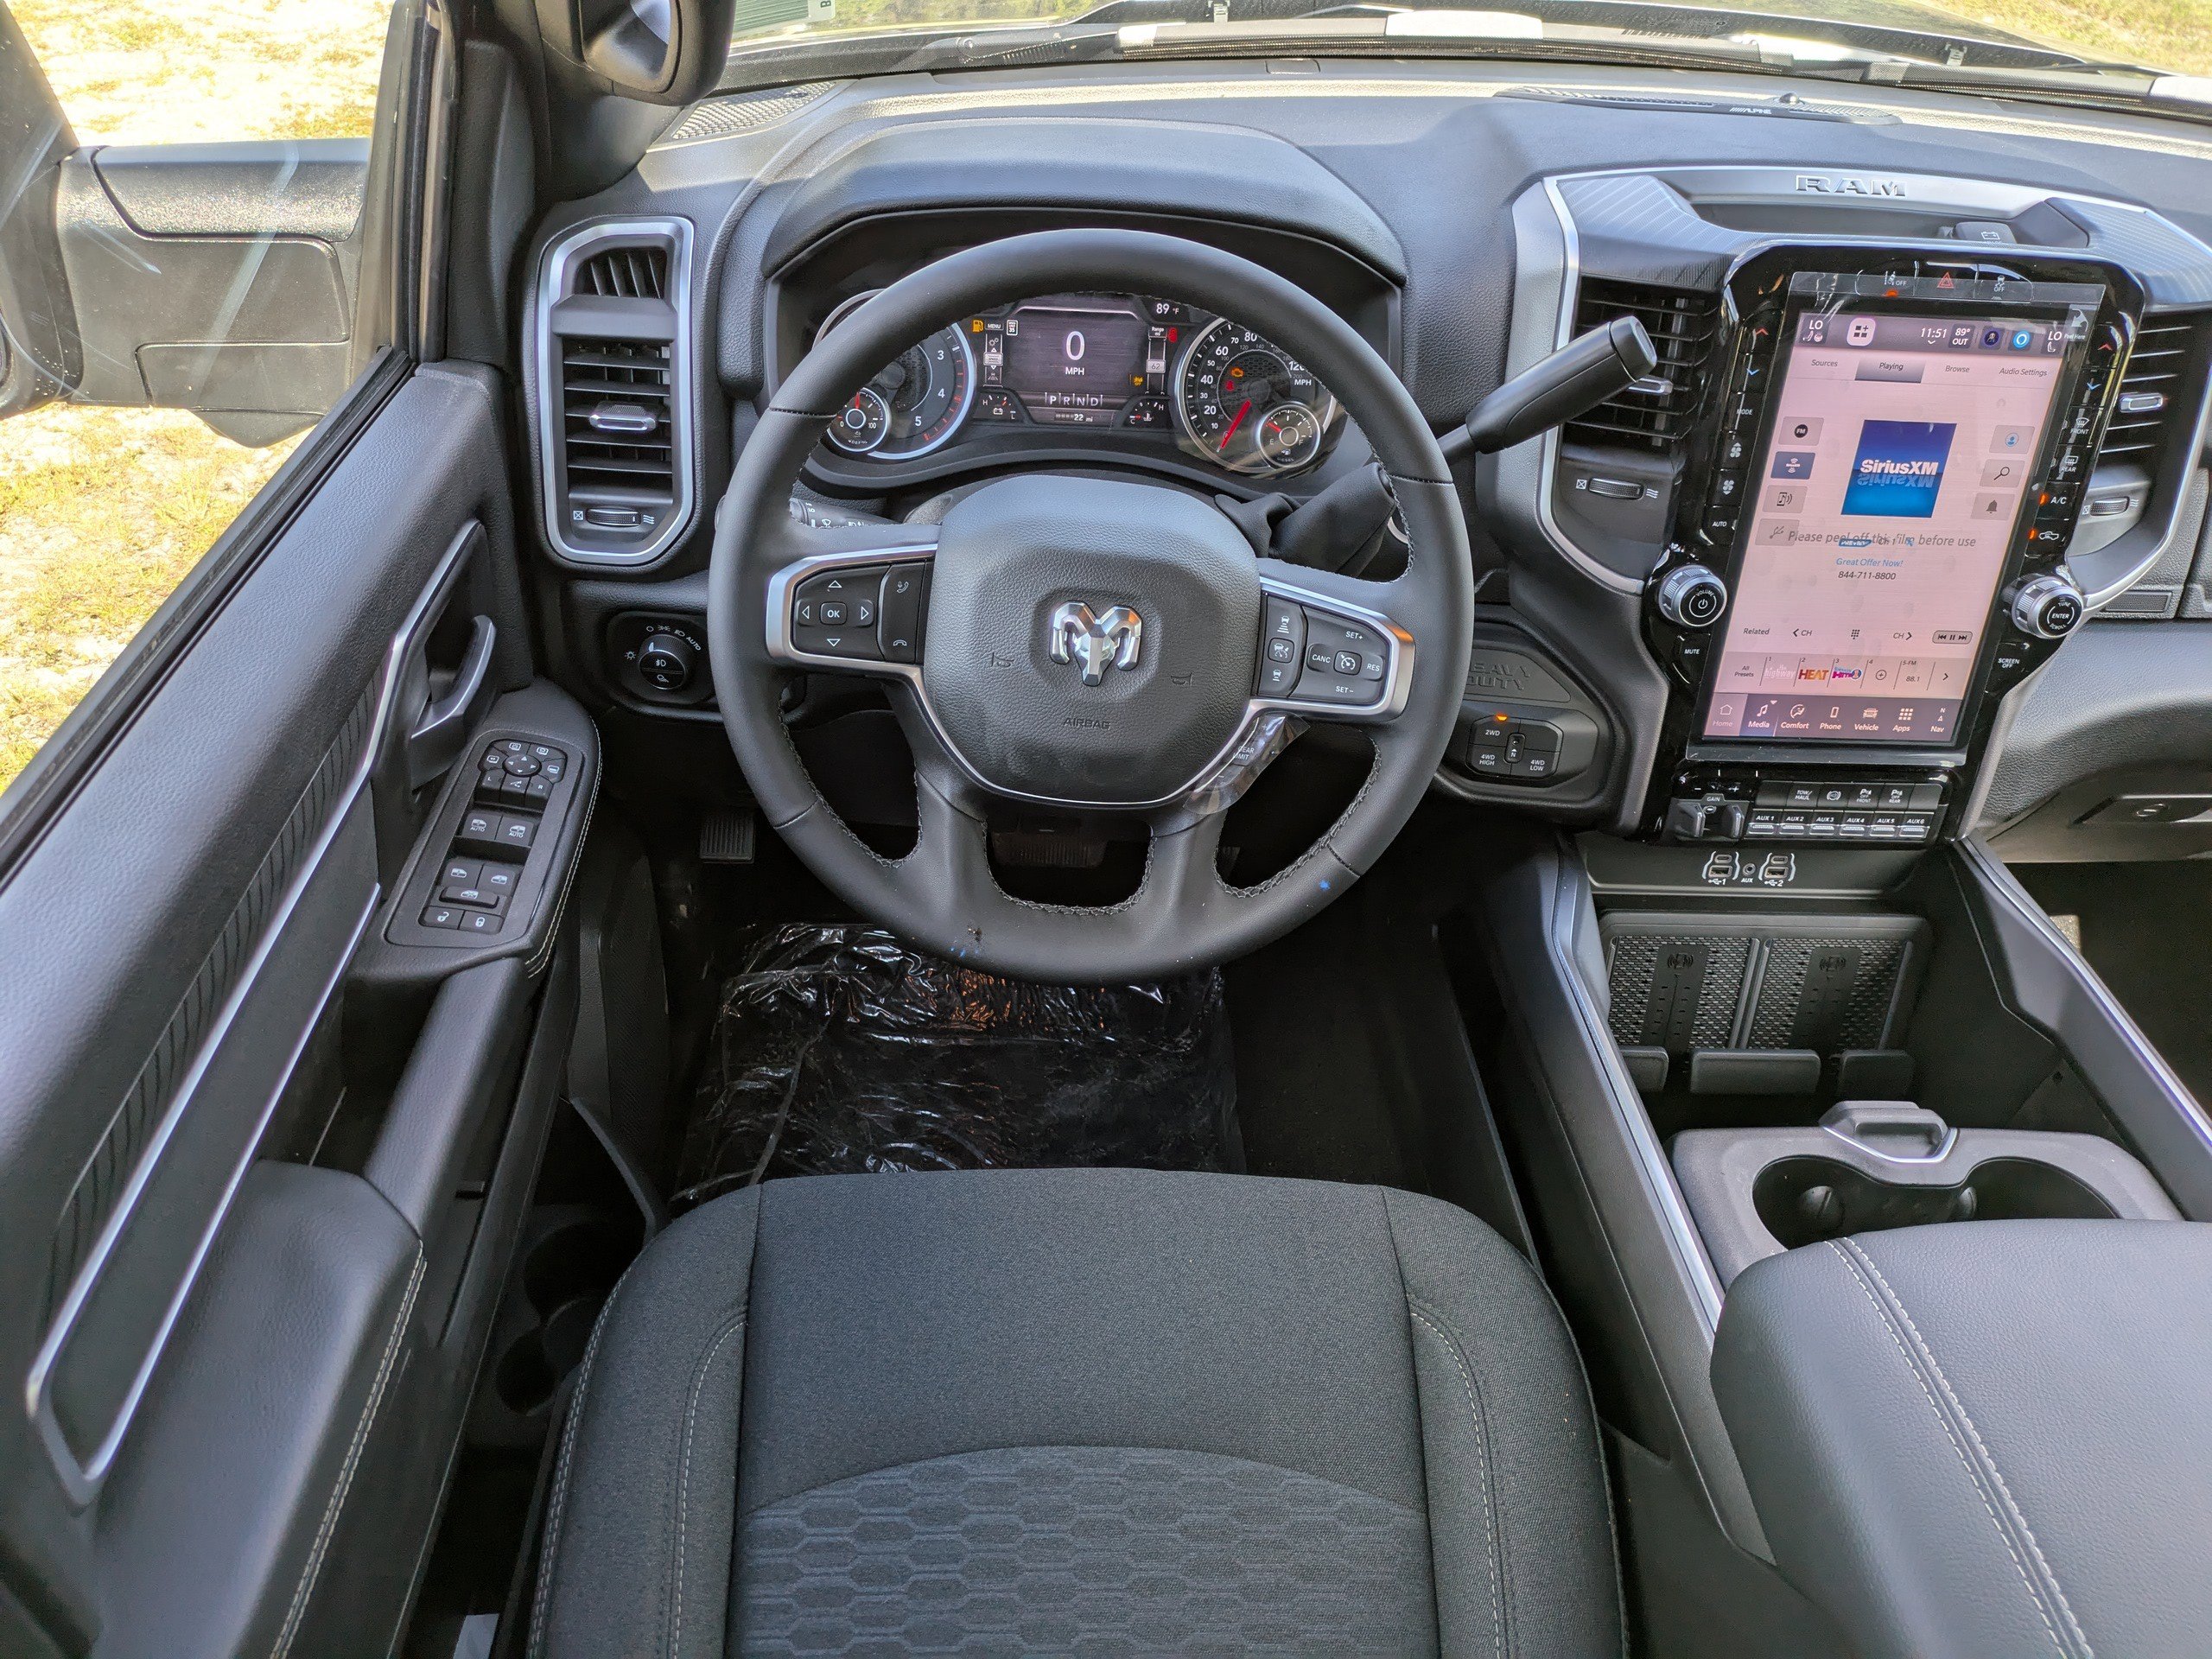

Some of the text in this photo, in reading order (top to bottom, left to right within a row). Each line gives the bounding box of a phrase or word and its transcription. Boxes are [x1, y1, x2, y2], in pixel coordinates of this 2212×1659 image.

[1795, 175, 1907, 197] RAM
[1156, 303, 1169, 315] 89
[1808, 320, 1823, 330] LO
[1244, 332, 1257, 342] 80
[1921, 327, 1948, 339] 11:51
[2048, 331, 2063, 341] LO
[1065, 330, 1085, 361] 0
[937, 350, 944, 360] 3
[1215, 346, 1229, 356] 60
[1065, 367, 1084, 376] MPH
[1878, 362, 1904, 371] Playing
[1945, 365, 1970, 373] Browse
[2020, 368, 2048, 377] Settings
[1200, 375, 1214, 385] 40
[938, 388, 945, 398] 4
[1050, 395, 1098, 406] P R N D
[1204, 405, 1217, 415] 20
[914, 416, 922, 426] 5
[1859, 459, 1940, 476] SiriusXM
[2050, 496, 2067, 505] A/C
[1788, 531, 1822, 543] Please
[1918, 534, 1954, 546] before
[1958, 537, 1976, 547] use
[1835, 557, 1859, 566] Great
[1859, 558, 1880, 567] Offer
[1838, 570, 1897, 580] 844-711-8800
[827, 609, 840, 618] OK
[686, 636, 702, 651] AUTO
[1312, 654, 1331, 664] CANC
[1366, 663, 1380, 672] RES
[1469, 663, 1530, 677] EAVY
[1798, 669, 1829, 680] HEAT
[1063, 717, 1111, 730] AIRBAG
